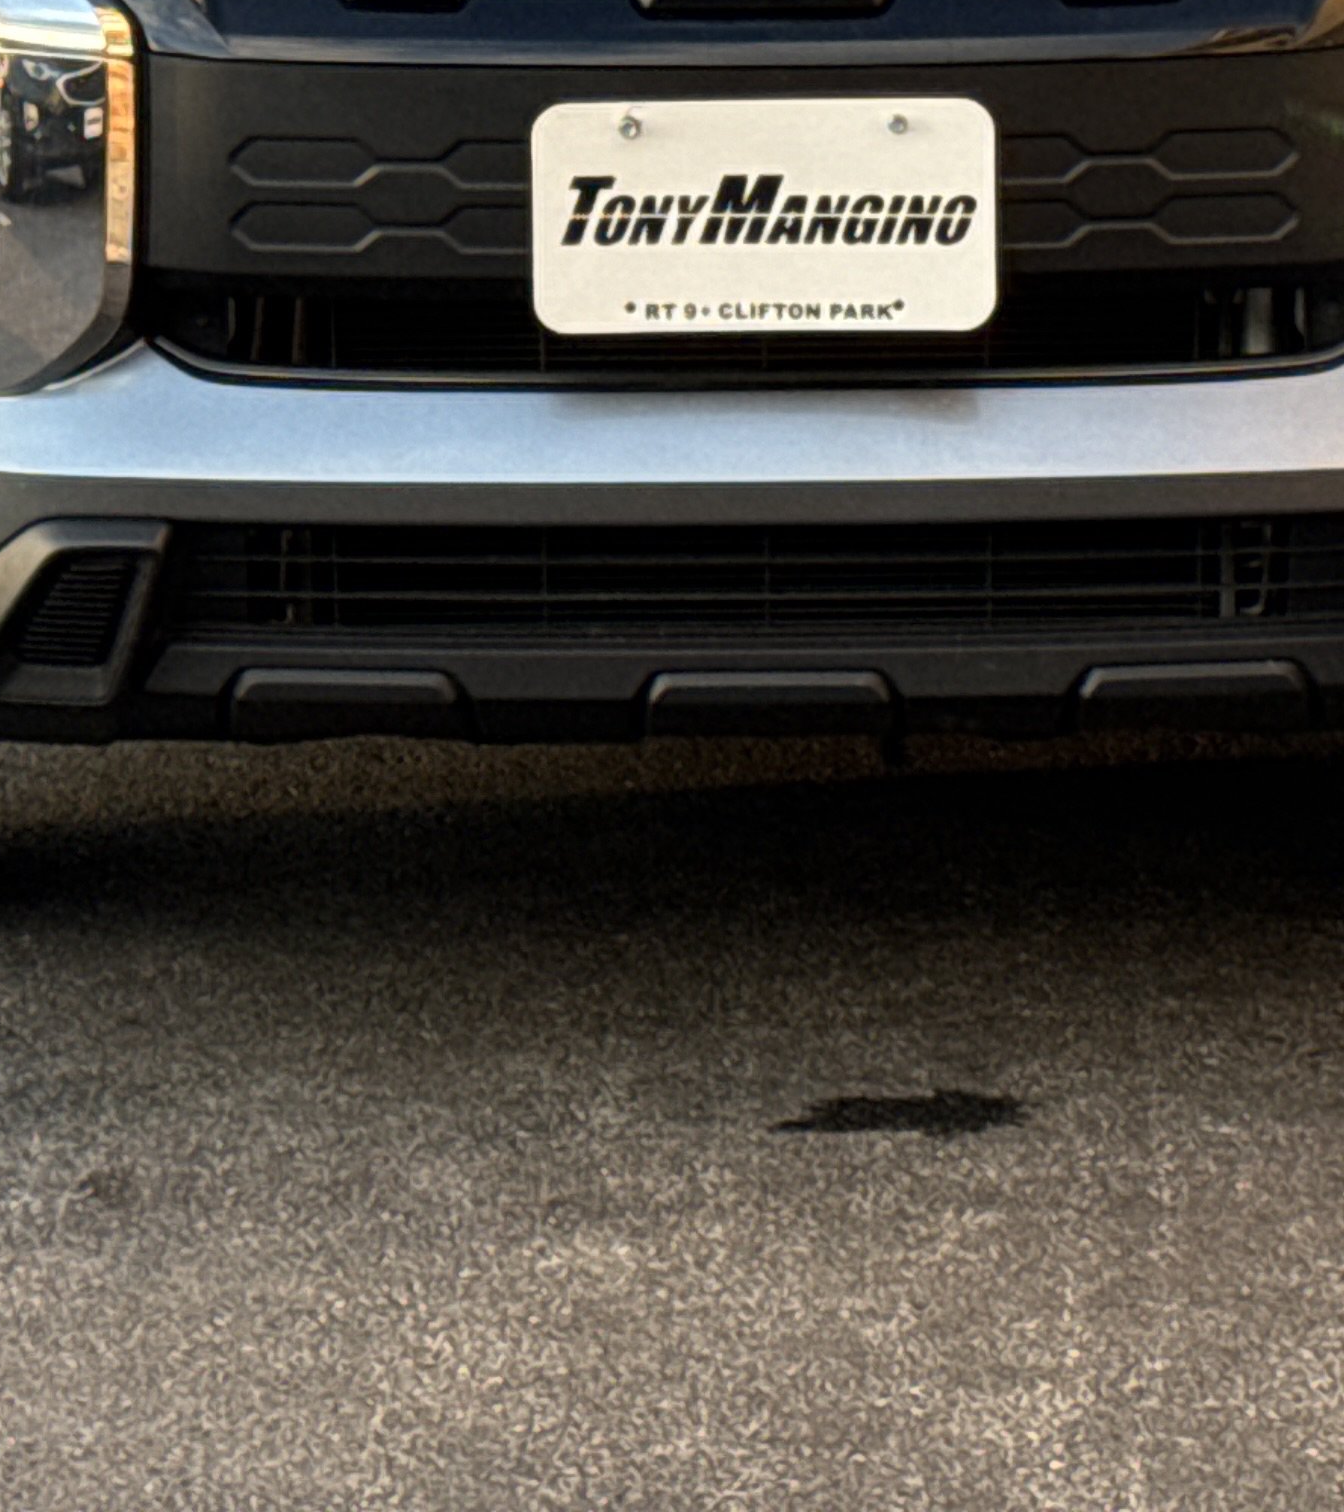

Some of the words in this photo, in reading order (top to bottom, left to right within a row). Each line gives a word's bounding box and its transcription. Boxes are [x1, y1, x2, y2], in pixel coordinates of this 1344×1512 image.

[645, 303, 677, 320] RT
[718, 302, 821, 320] CLIFTON
[829, 302, 894, 320] PARK
